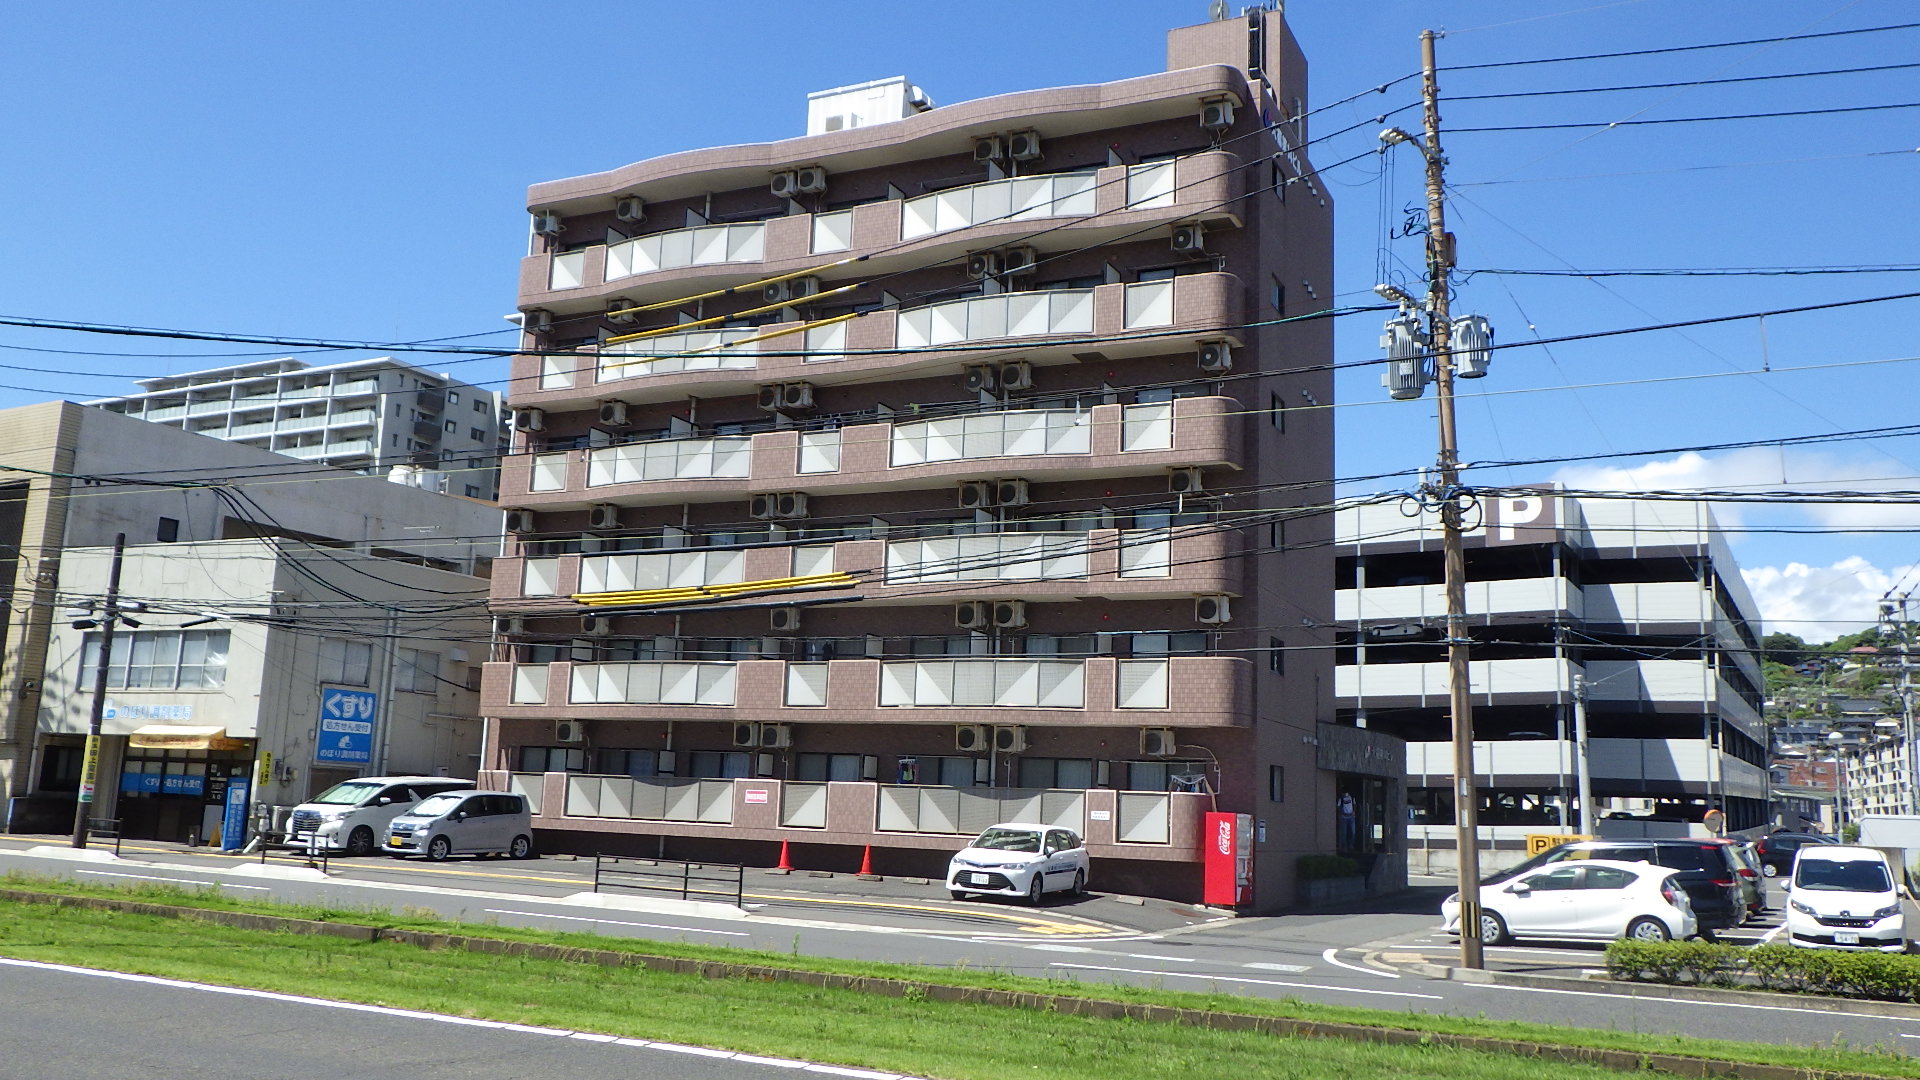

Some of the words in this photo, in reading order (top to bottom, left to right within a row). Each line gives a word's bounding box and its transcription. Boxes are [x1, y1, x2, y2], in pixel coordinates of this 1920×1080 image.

[1499, 496, 1543, 540] P
[120, 705, 193, 720] のぼり調剤薬局
[325, 692, 374, 719] くすり
[326, 721, 369, 733] 処方せん受付
[1536, 839, 1547, 851] P
